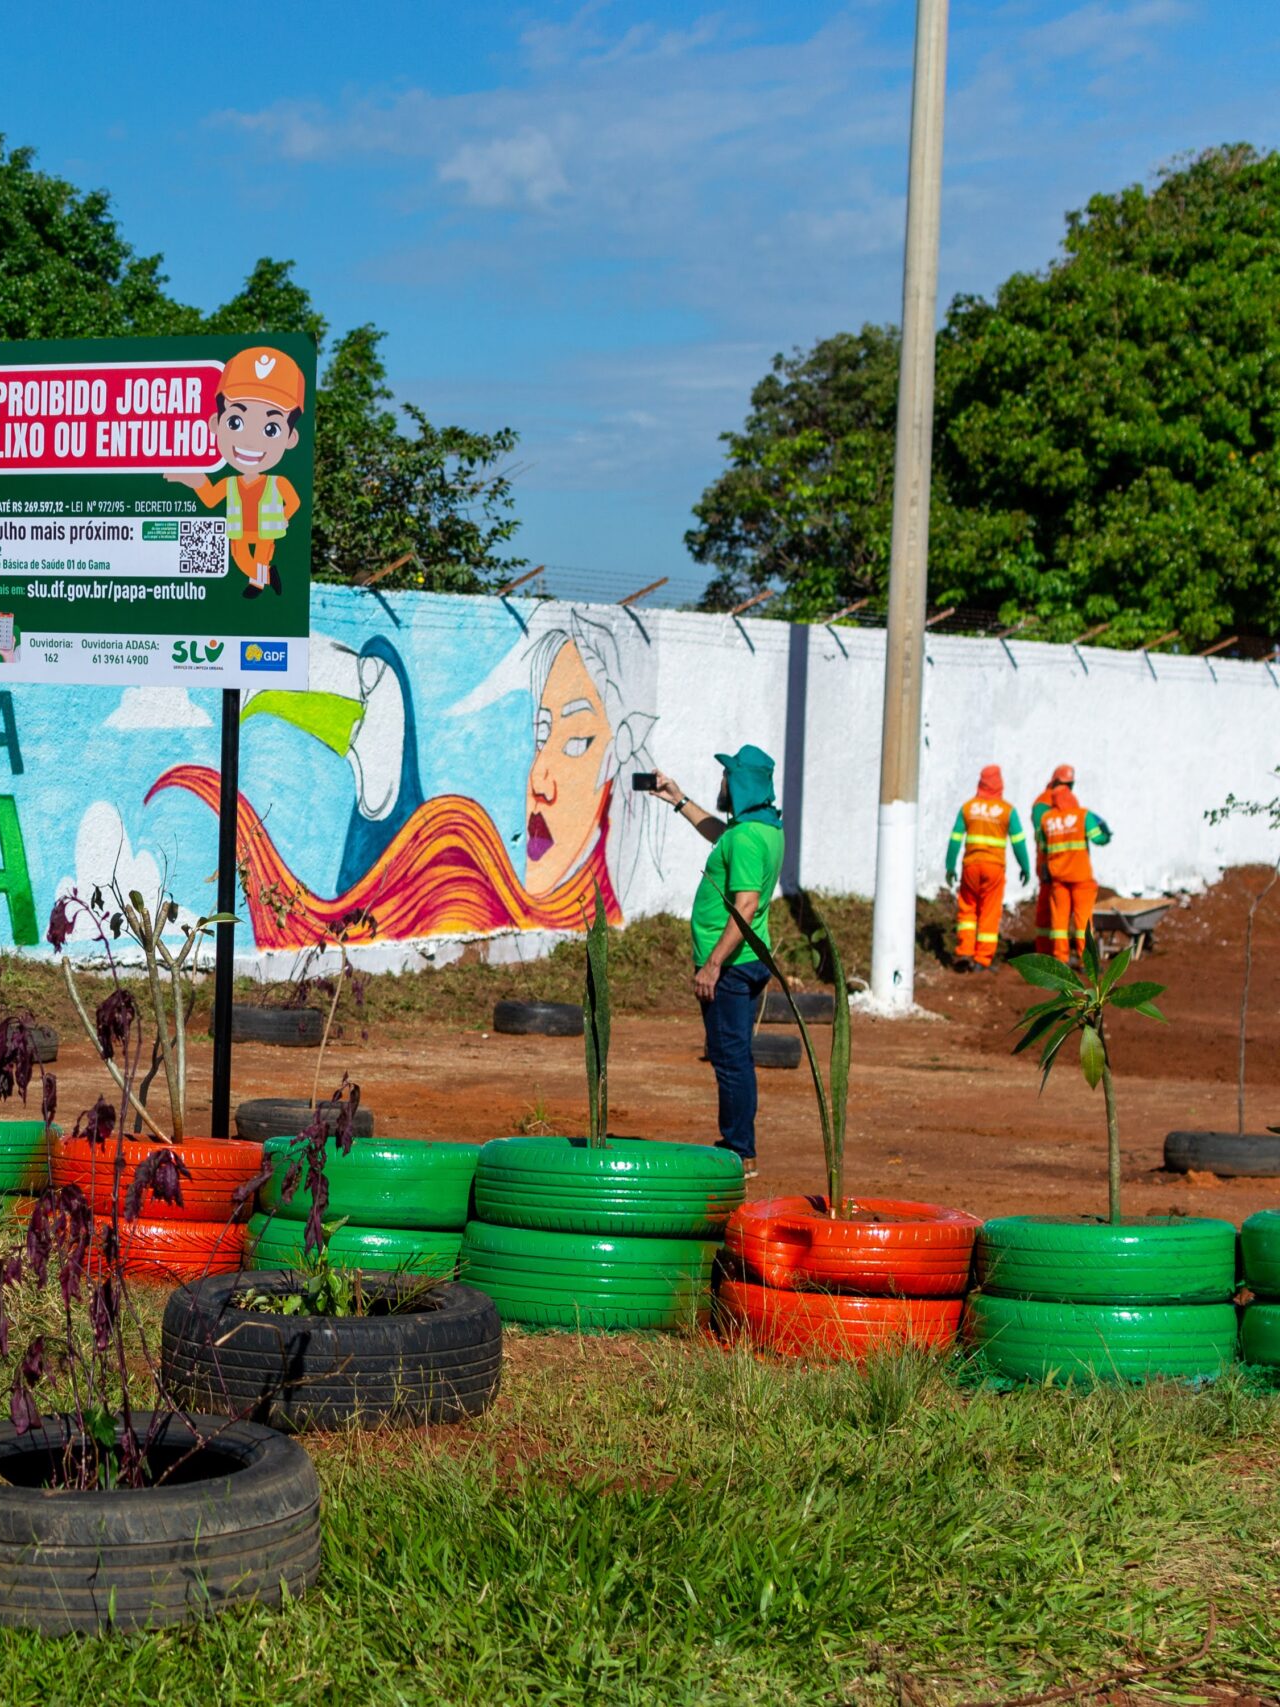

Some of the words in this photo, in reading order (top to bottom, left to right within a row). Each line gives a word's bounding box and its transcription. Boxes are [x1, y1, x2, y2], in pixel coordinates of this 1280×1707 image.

[116, 377, 202, 415] JOGAR
[54, 421, 87, 458] OU
[95, 420, 217, 457] ENTULHO!
[12, 501, 22, 513] R$
[24, 501, 63, 514] 269.597,12
[71, 502, 83, 513] LEI
[98, 501, 125, 513] 972/95
[135, 501, 172, 513] DECRETO
[174, 501, 197, 513] 17.156
[31, 522, 65, 541] mais
[70, 520, 134, 545] próximo:
[3, 559, 28, 570] Básica
[31, 559, 39, 570] de
[41, 559, 64, 570] Saúde
[67, 560, 75, 570] 01
[77, 560, 86, 570] do
[88, 560, 111, 570] Gama
[11, 585, 25, 595] em:
[27, 580, 206, 603] slu.df.gov.br/papa-entulho
[29, 638, 73, 648] Ouvidoria:
[81, 639, 123, 649] Ouvidoria
[125, 640, 159, 650] ADASA:
[172, 639, 224, 663] SLU
[263, 651, 286, 662] GDF
[44, 653, 59, 663] 162
[92, 654, 101, 664] 61
[104, 655, 124, 664] 3961
[126, 655, 148, 665] 4900
